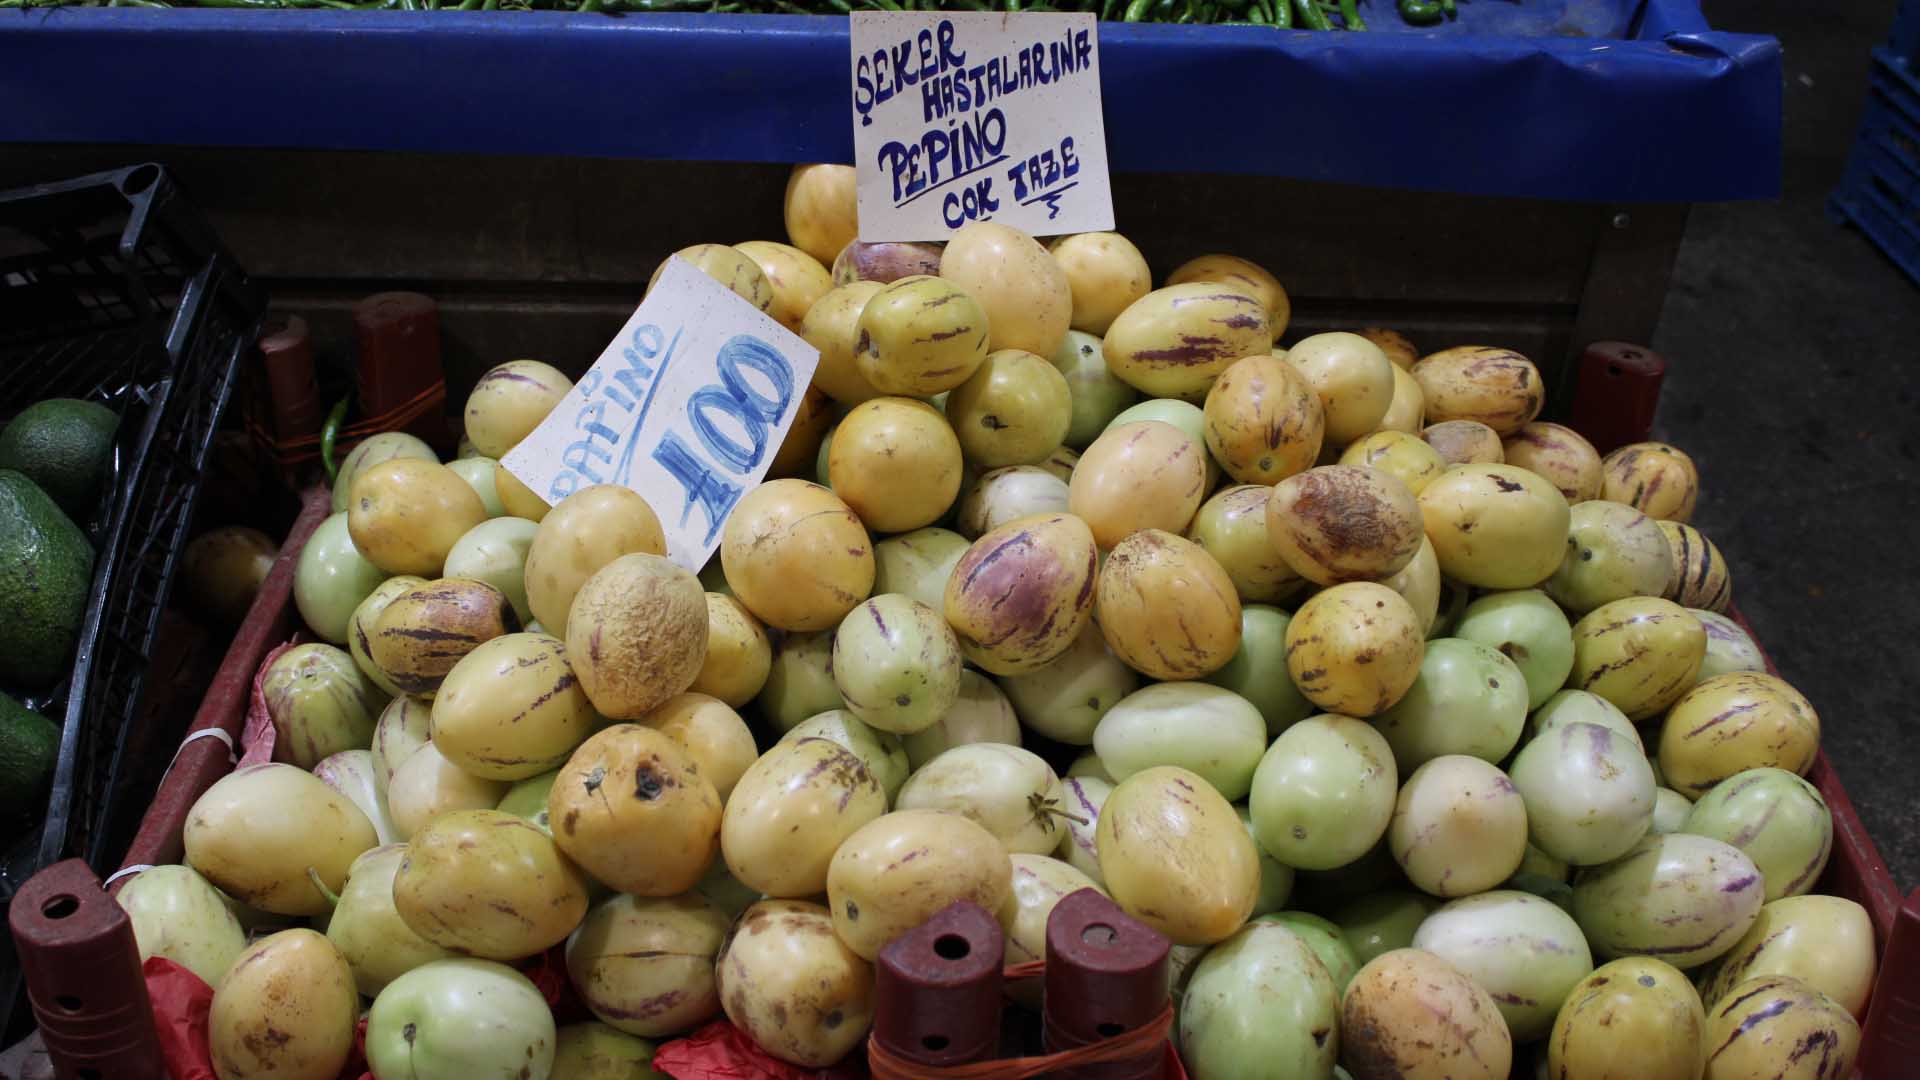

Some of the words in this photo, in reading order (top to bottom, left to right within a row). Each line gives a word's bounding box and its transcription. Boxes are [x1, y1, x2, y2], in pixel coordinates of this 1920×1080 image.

[855, 20, 966, 127] ŞEKER
[921, 27, 1092, 123] HASTALARINA
[1008, 136, 1080, 201] TAZE
[651, 333, 795, 549] 100
